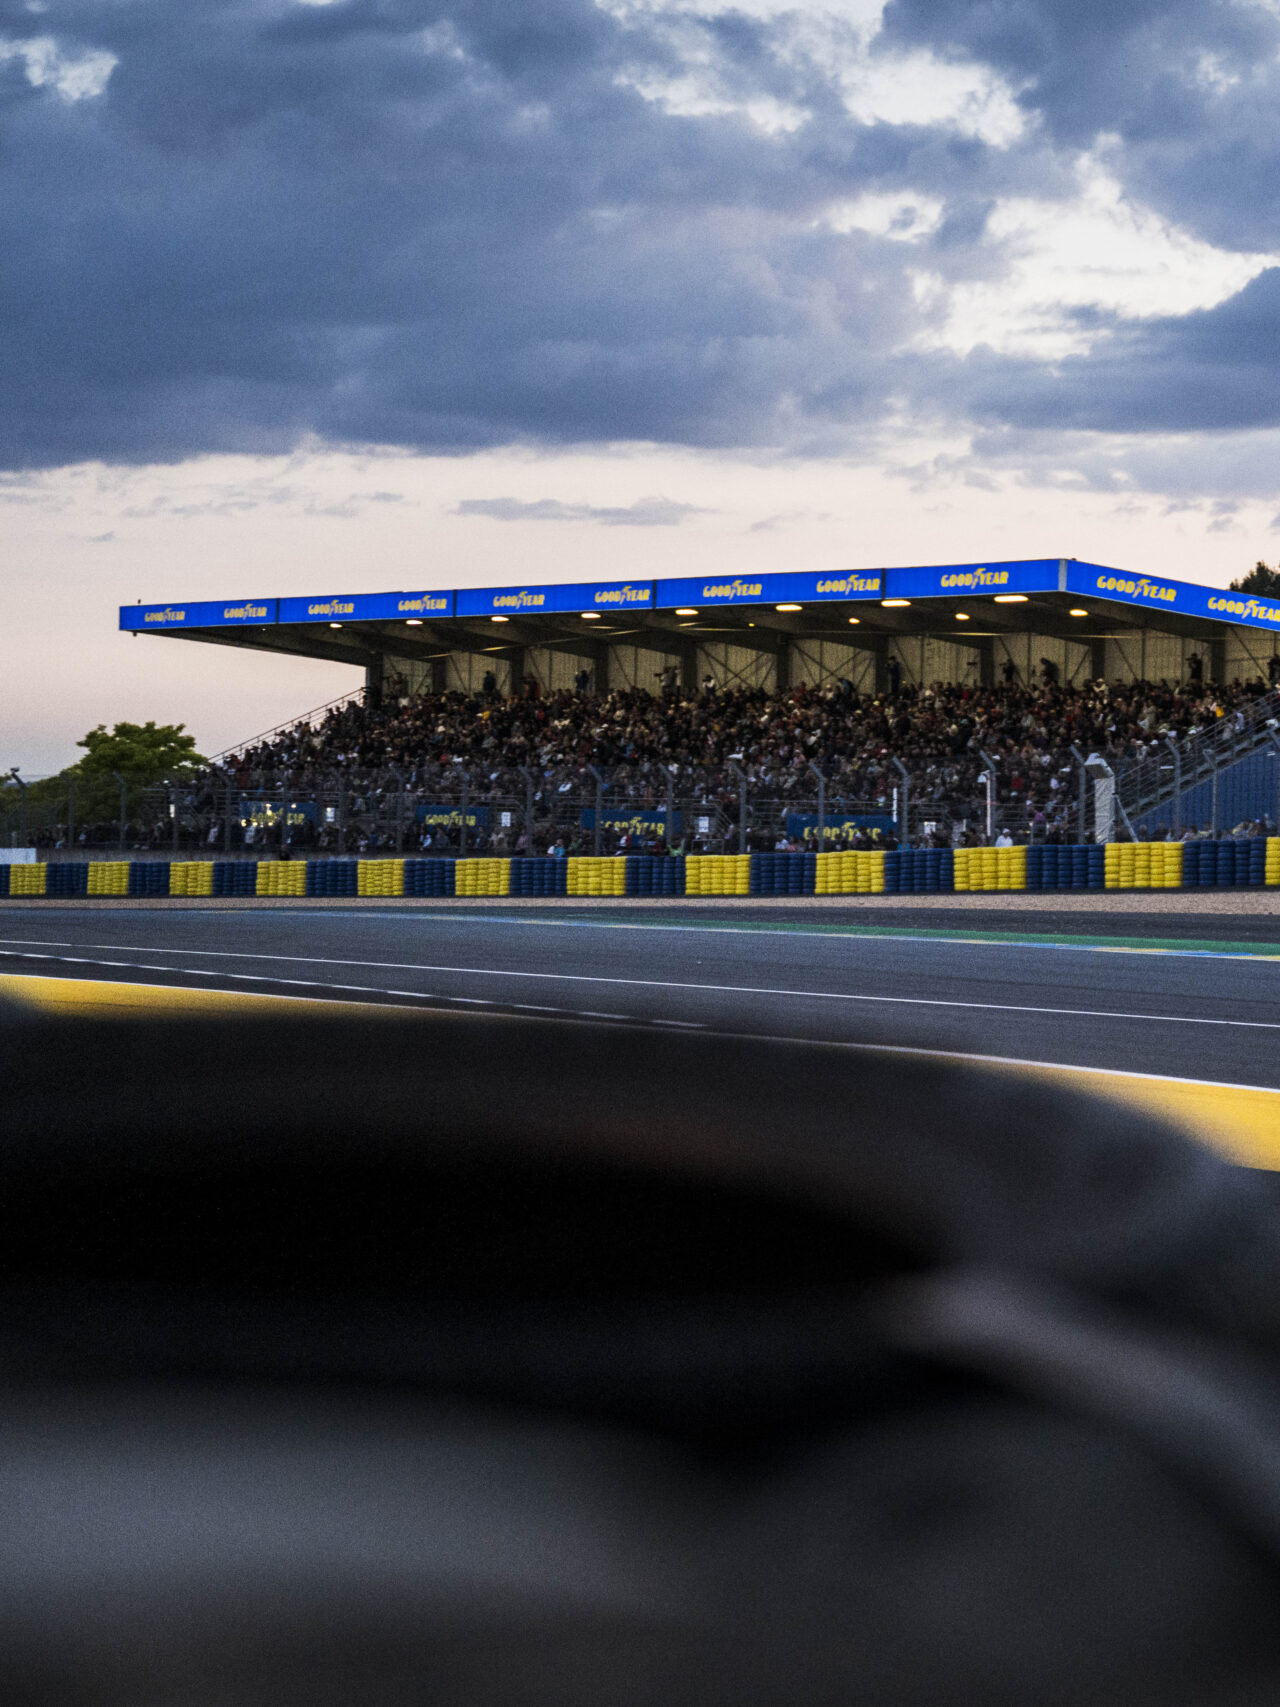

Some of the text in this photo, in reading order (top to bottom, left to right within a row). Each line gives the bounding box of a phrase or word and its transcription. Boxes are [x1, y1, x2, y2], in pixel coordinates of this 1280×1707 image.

[816, 575, 881, 597] GOODYEAR
[940, 568, 1009, 591] GOODYEAR
[594, 586, 651, 606] GOODYEAR
[702, 580, 763, 601] GOODYEAR
[1096, 576, 1177, 603] GOODYEAR
[307, 600, 355, 618] GOODYEAR
[397, 595, 448, 614] GOODYEAR
[492, 591, 546, 610] GOODYEAR
[144, 608, 186, 624] GOODYEAR
[223, 604, 268, 621] GOODYEAR
